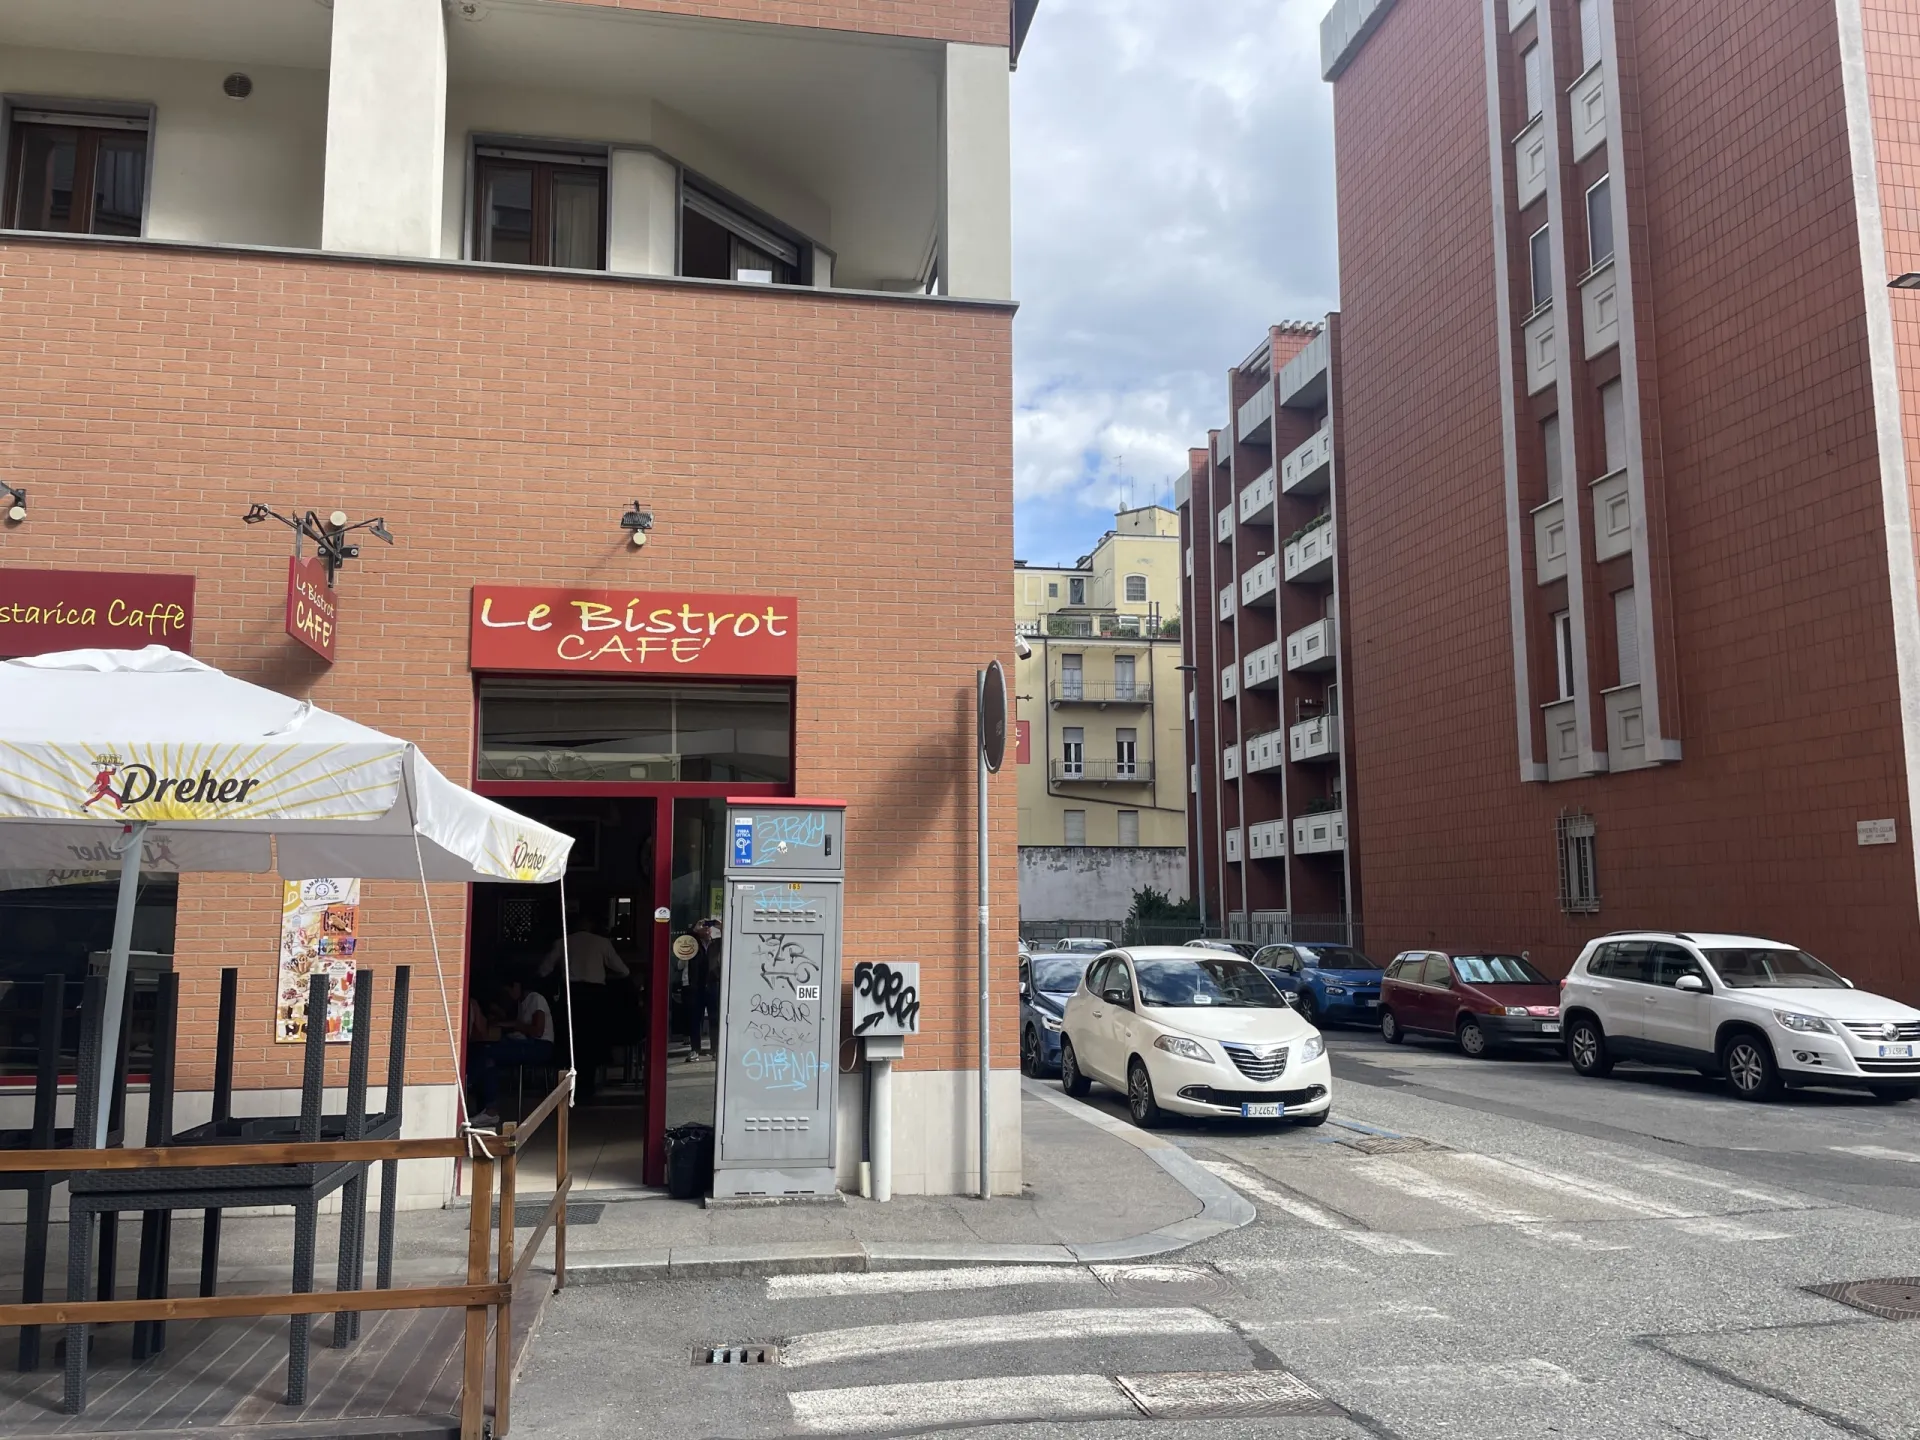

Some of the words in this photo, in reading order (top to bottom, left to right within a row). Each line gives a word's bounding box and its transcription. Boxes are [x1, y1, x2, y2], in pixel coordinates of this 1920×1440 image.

[296, 573, 306, 596] Le
[307, 582, 335, 619] Bistrot
[0, 601, 96, 626] starica
[107, 598, 186, 636] Caffè
[480, 597, 553, 632] Le
[570, 597, 789, 638] Bistrot
[557, 633, 712, 664] CAFE'
[120, 763, 261, 804] Dreher
[515, 841, 547, 871] Dreher
[798, 986, 819, 999] BNE
